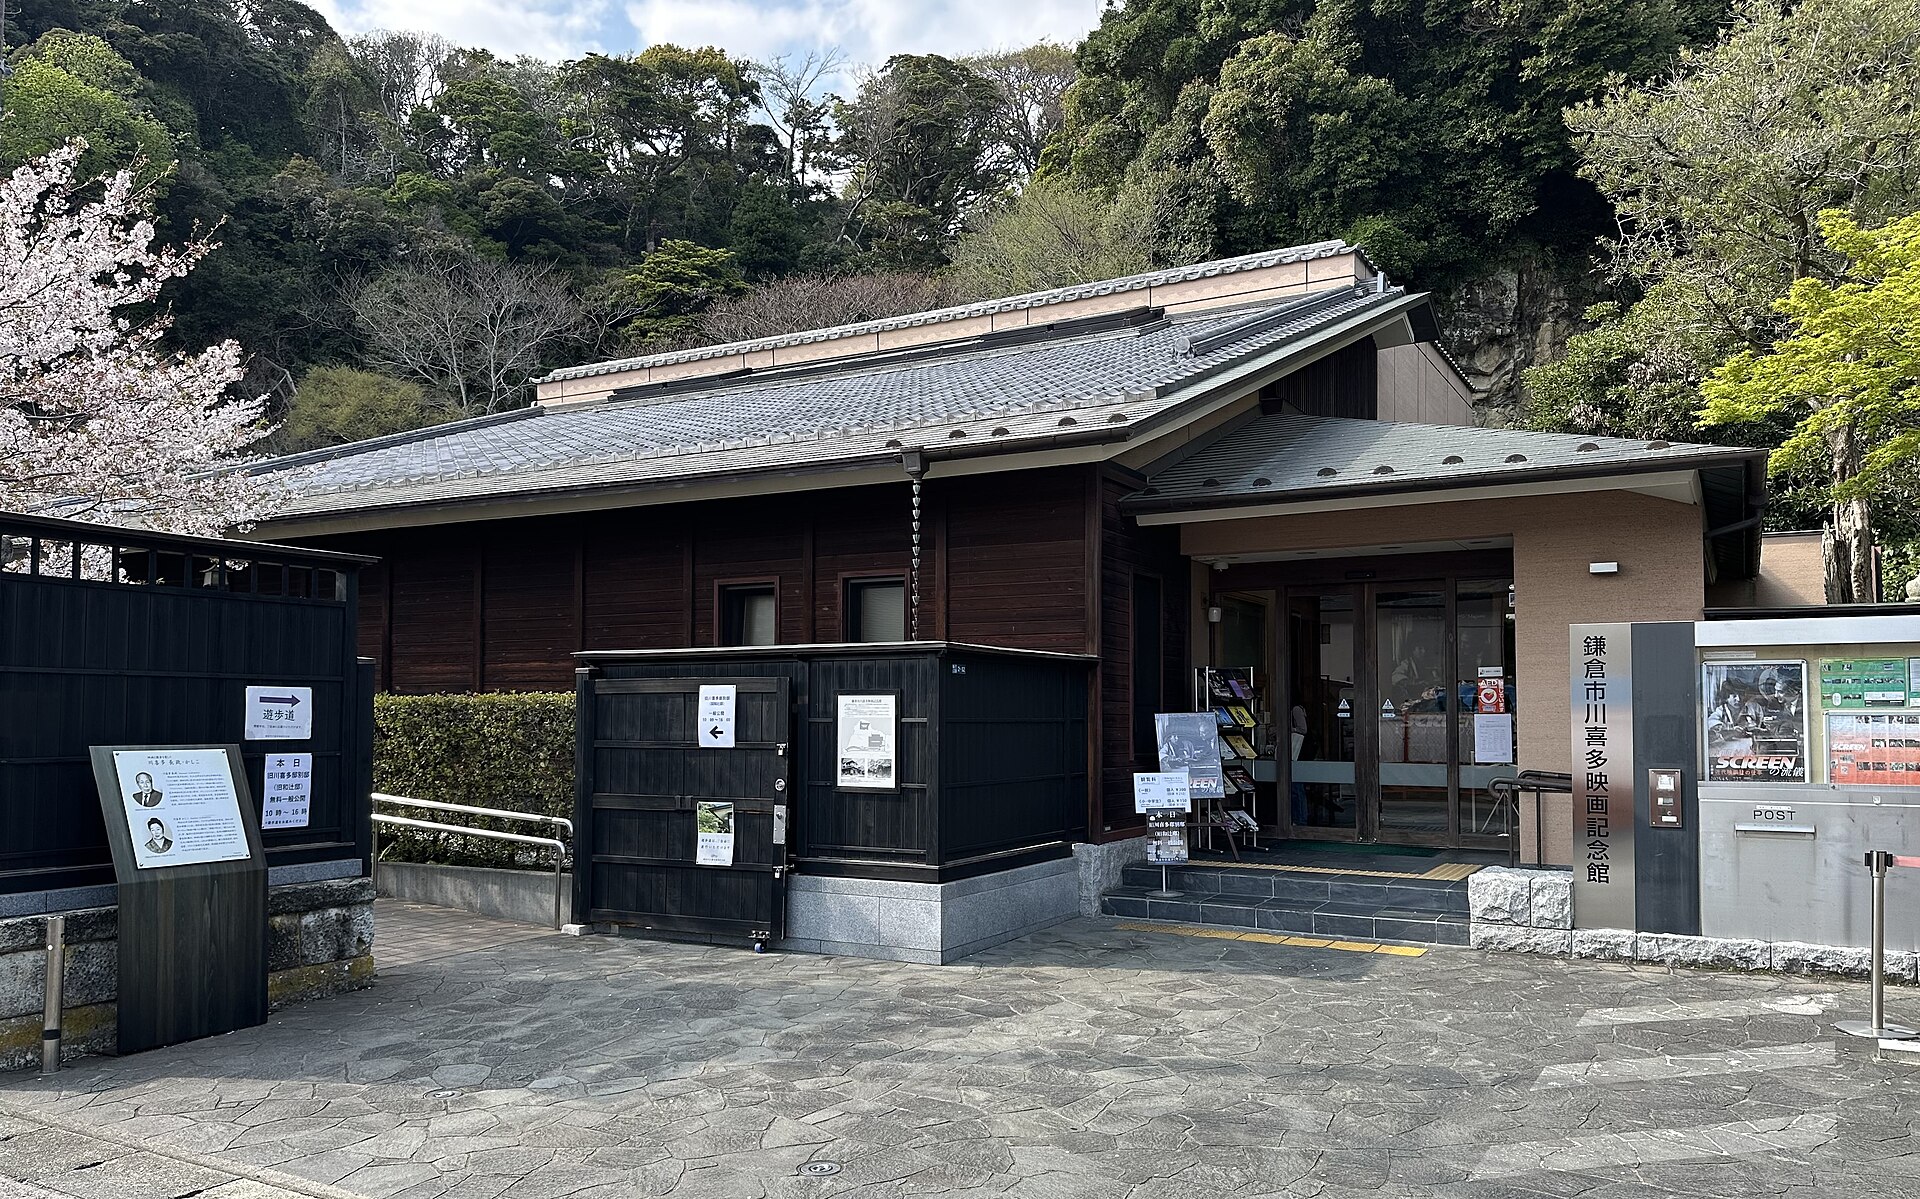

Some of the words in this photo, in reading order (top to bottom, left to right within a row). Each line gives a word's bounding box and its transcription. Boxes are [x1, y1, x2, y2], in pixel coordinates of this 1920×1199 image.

[1480, 679, 1498, 687] AED
[262, 708, 296, 722] 遊歩道
[1583, 635, 1610, 884] 鎌倉市川喜多映画記念館
[1715, 756, 1796, 769] SCREEN
[1769, 766, 1804, 777] の流儀
[267, 771, 310, 780] 旧川喜多邸別邸
[269, 794, 306, 804] 無料一般公開
[1753, 810, 1796, 821] POST
